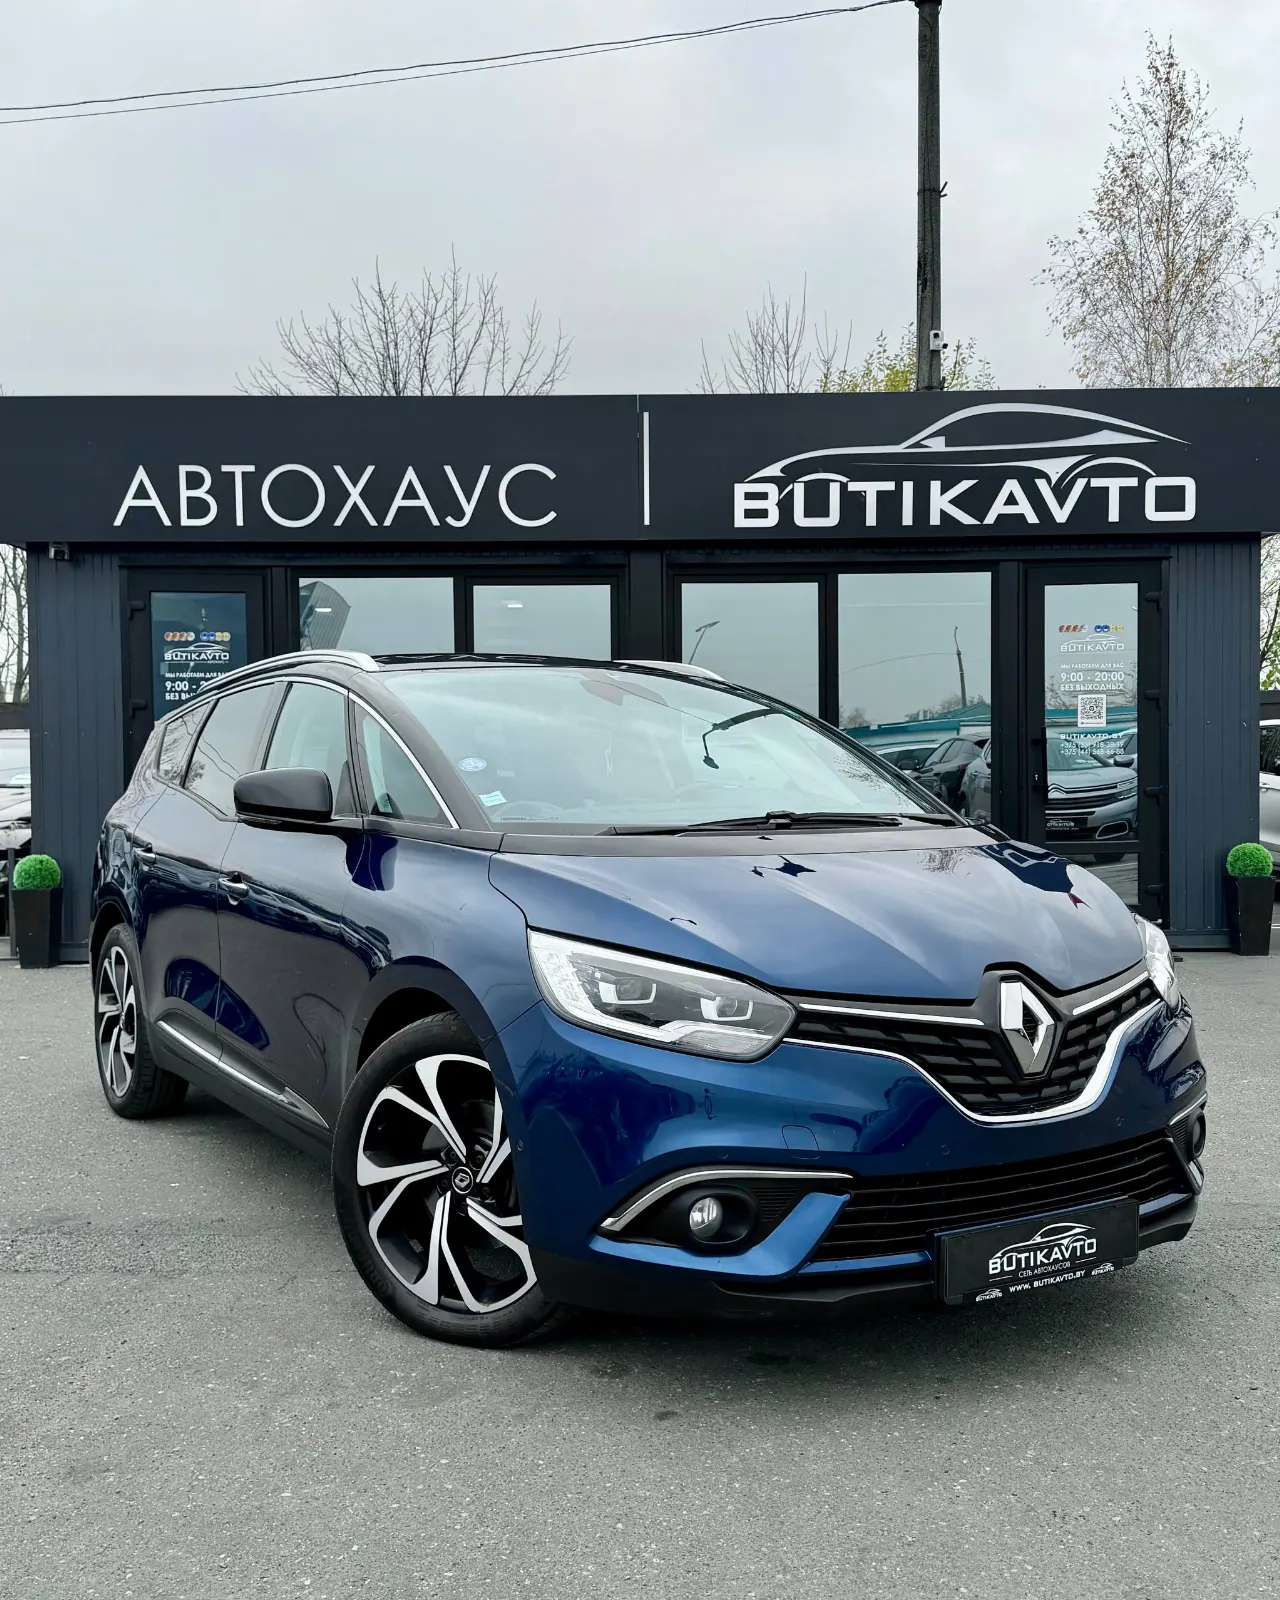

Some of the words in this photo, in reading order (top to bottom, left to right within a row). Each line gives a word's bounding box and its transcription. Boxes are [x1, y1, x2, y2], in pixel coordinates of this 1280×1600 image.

[113, 463, 559, 527] АВТОХАУС
[733, 475, 1197, 528] BUTIKAVTO
[1060, 643, 1125, 652] BUTIKAVTO
[164, 652, 230, 661] BUTIKAVTO
[1060, 672, 1084, 682] 9:00
[1094, 671, 1125, 682] 20:00
[165, 681, 189, 691] 9:00
[1060, 683, 1074, 691] БЕЗ
[1075, 683, 1124, 691] ВЫХОДНЫХ
[988, 1238, 1097, 1275] BUTIKAVTO
[1018, 1269, 1033, 1278] СЕТЬ
[1033, 1261, 1071, 1275] АВТОХАУСОВ
